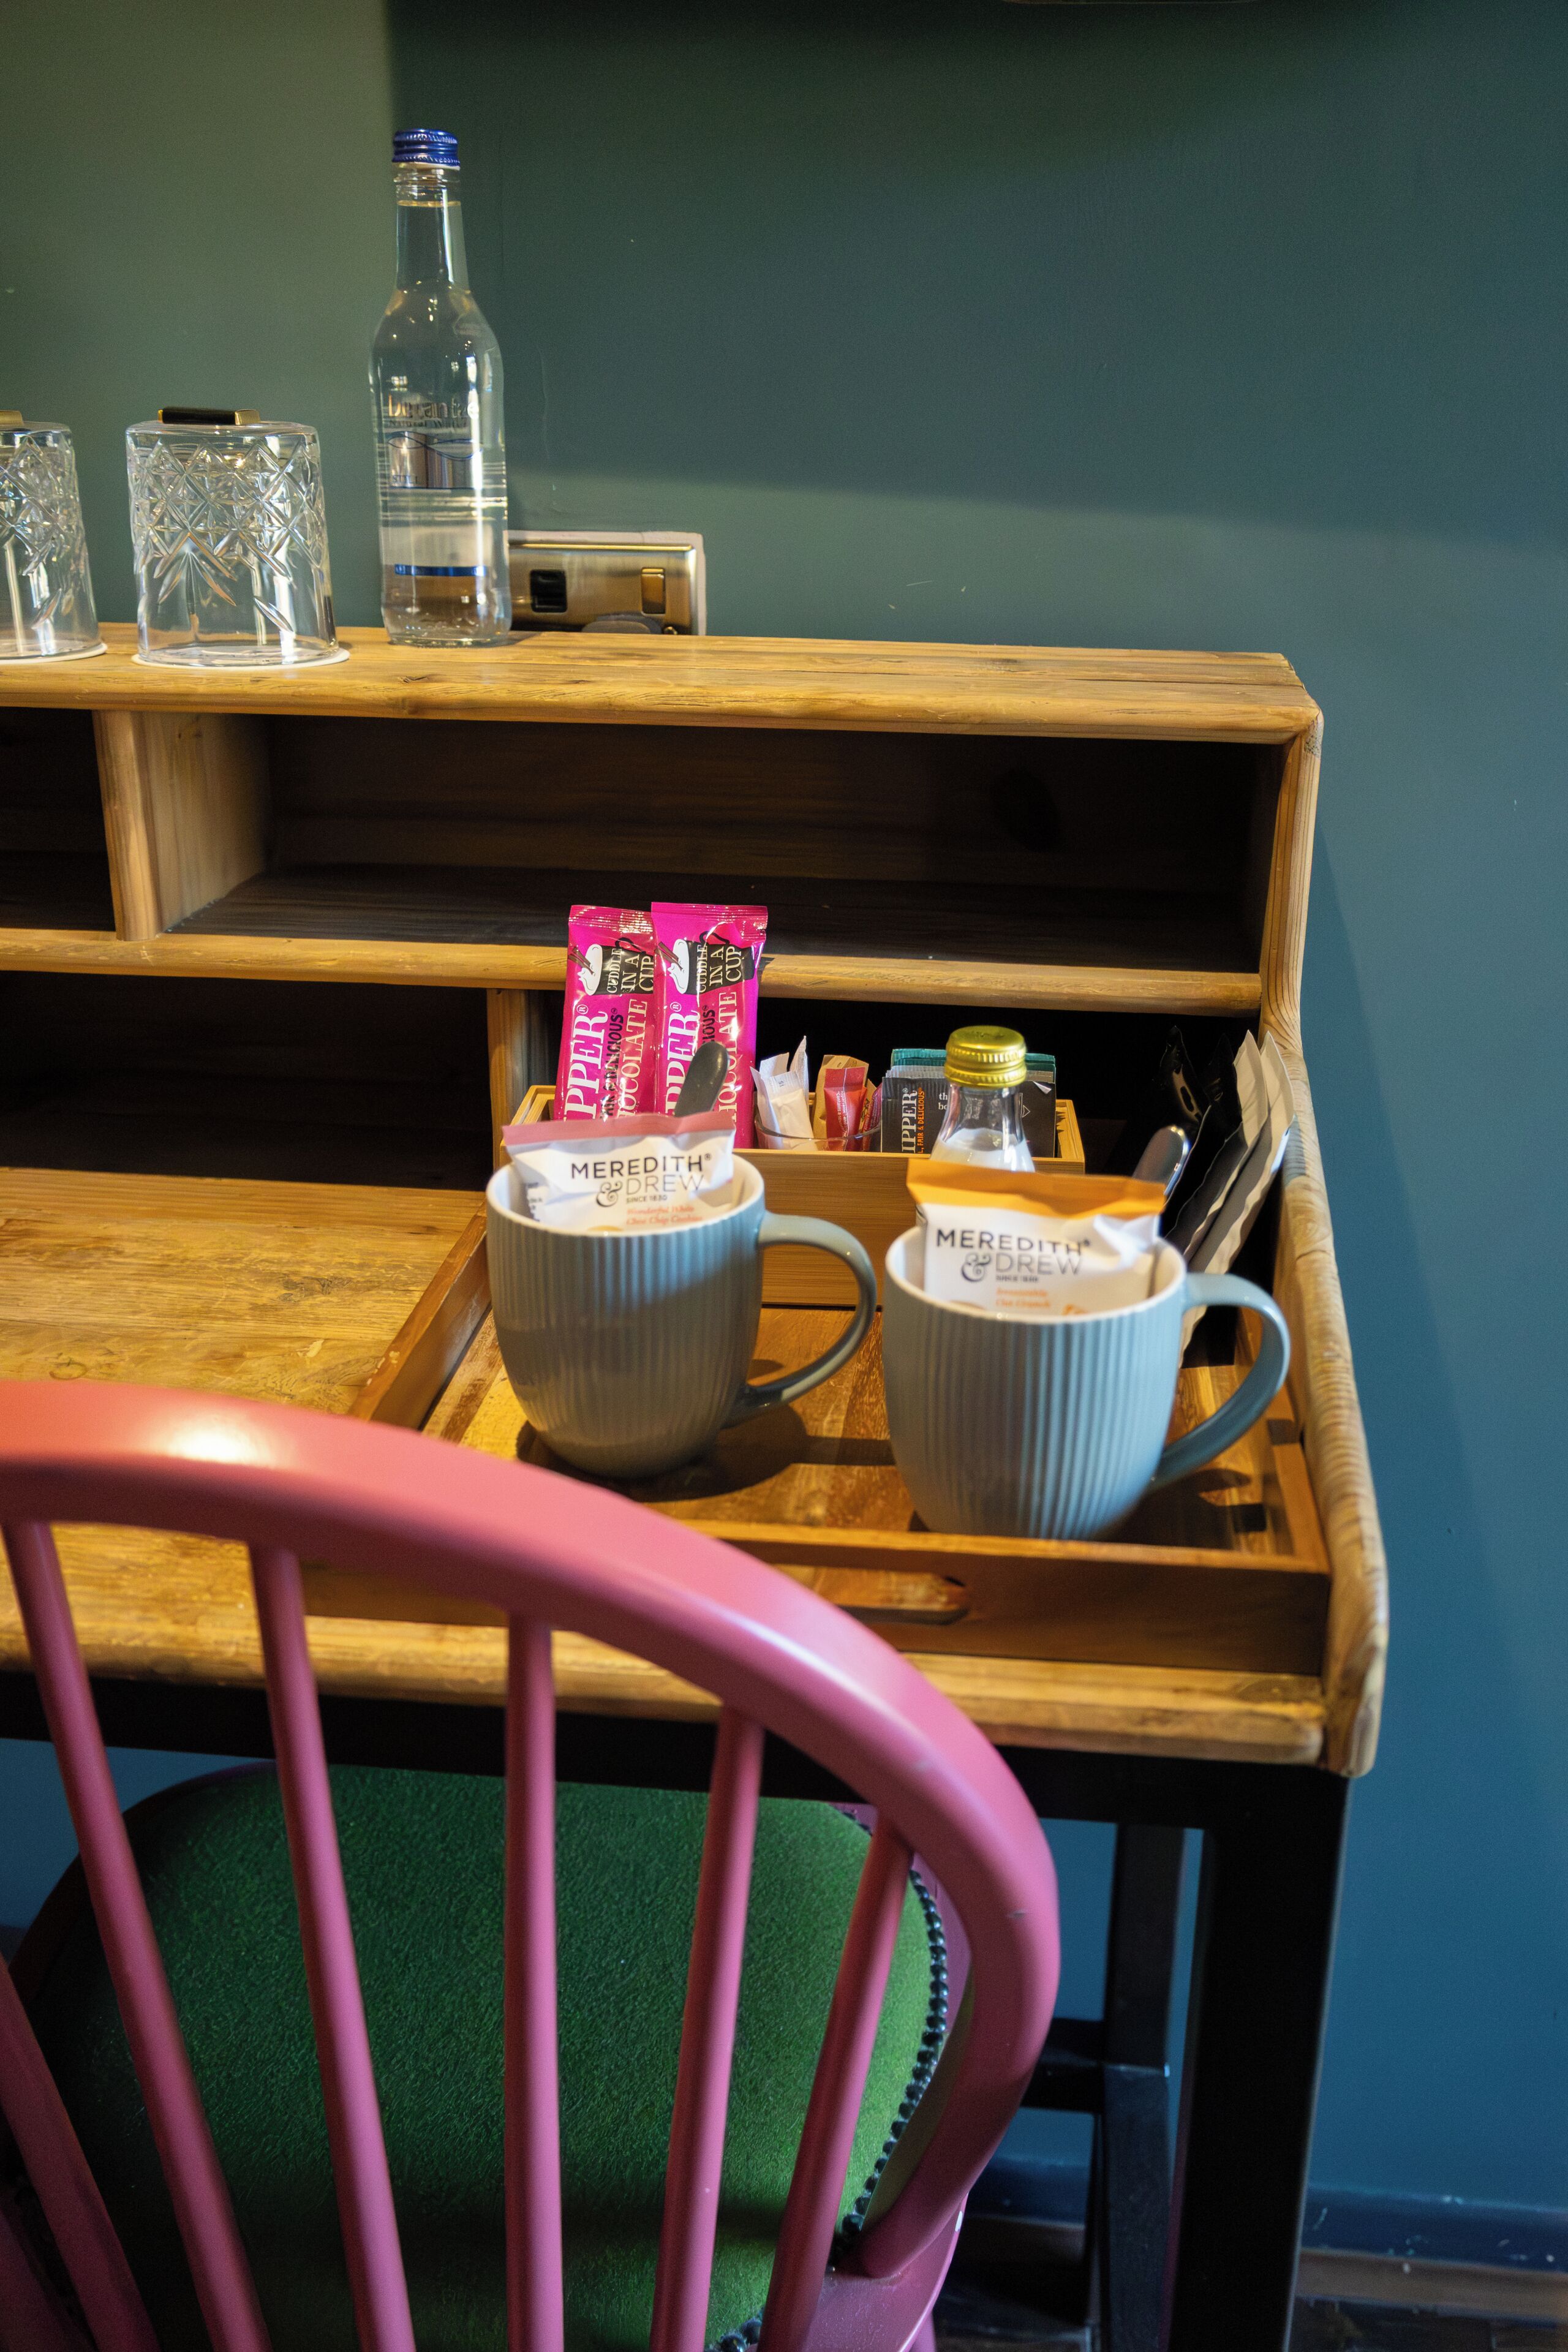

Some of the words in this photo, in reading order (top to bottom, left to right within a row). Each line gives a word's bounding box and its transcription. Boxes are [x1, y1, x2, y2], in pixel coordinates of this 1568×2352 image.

[625, 954, 639, 968] A
[696, 944, 708, 993] CUDDLE
[710, 946, 724, 960] A
[726, 946, 742, 982] CUP
[606, 948, 622, 993] CUDDLE
[621, 971, 637, 991] IN
[639, 956, 654, 992] CUP
[709, 965, 723, 987] IN
[703, 1005, 715, 1043] IOUS®
[564, 1004, 608, 1121] PPER®
[596, 1181, 623, 1207] &
[626, 1174, 704, 1195] DREW
[960, 1252, 992, 1283] &
[995, 1253, 1082, 1275] DREW
